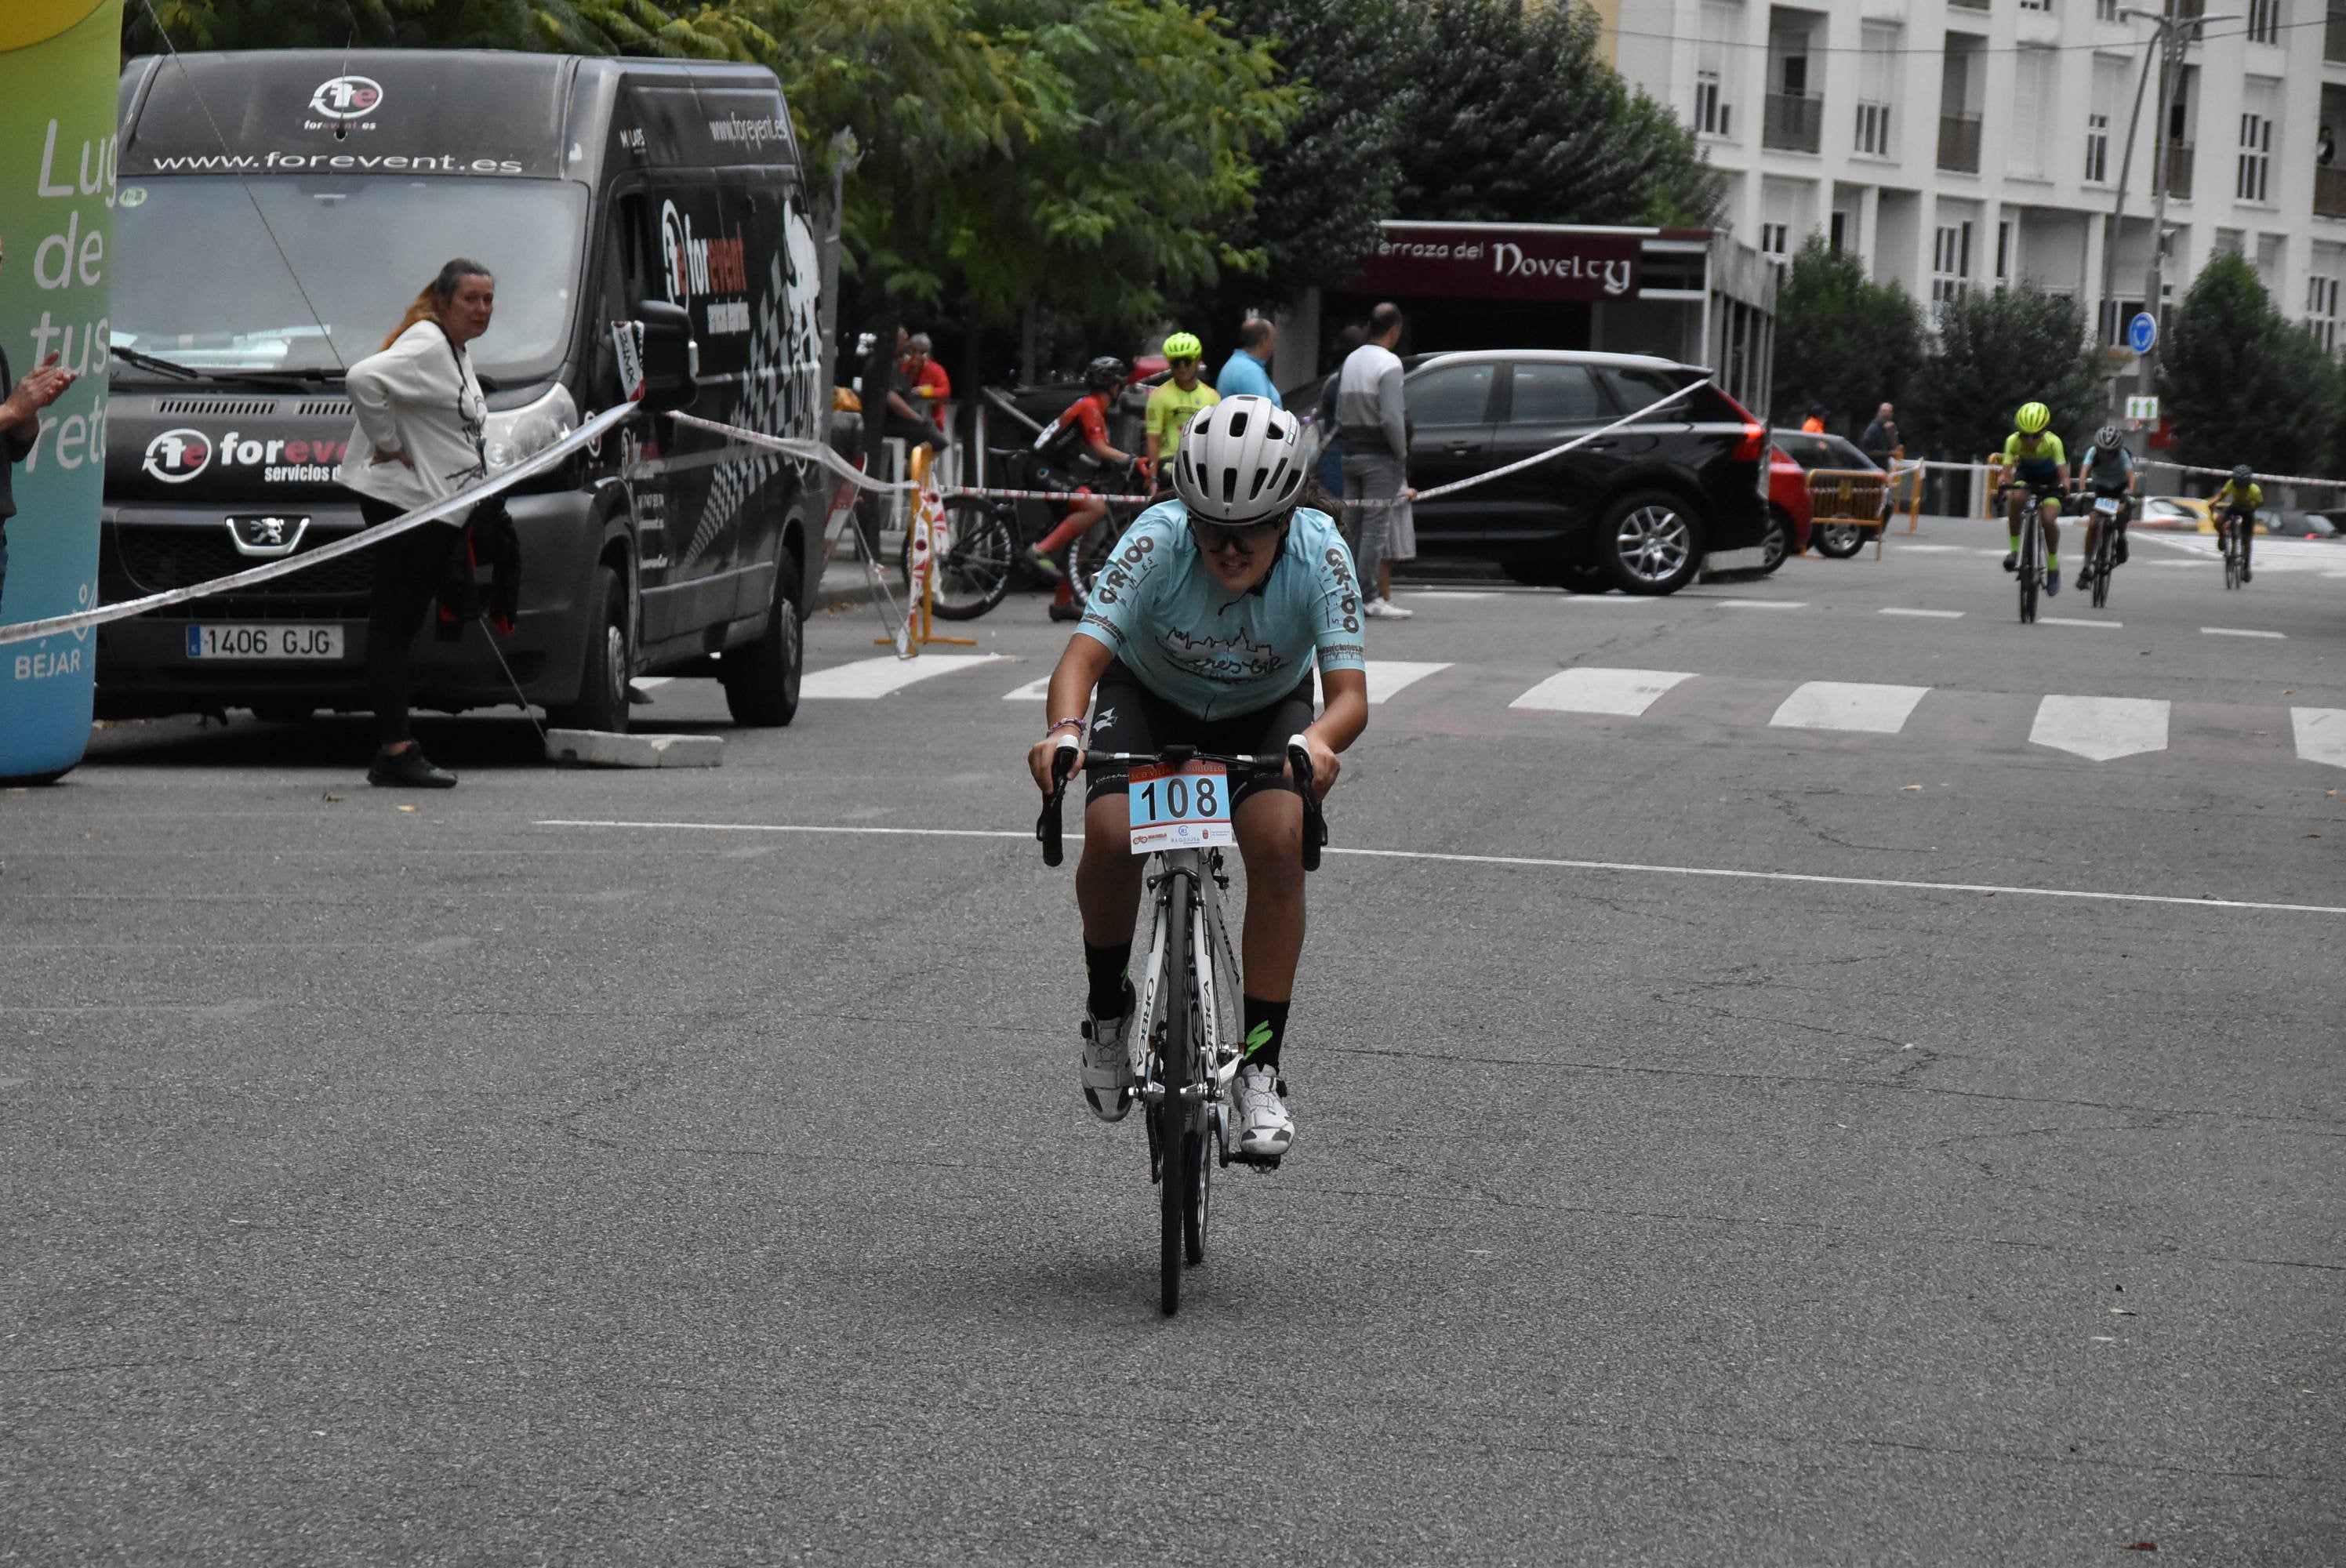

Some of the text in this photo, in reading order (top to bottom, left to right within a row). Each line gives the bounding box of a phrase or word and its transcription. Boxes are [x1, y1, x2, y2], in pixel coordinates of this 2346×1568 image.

[303, 119, 377, 131] forevnt.es
[709, 111, 788, 151] www.forevent.es
[154, 151, 523, 174] www.forevent.es
[34, 210, 103, 289] de
[685, 213, 747, 296] forevent
[1454, 241, 1484, 259] del
[1492, 242, 1632, 295] Novelty
[31, 311, 109, 377] tus
[25, 395, 108, 473] ret
[264, 464, 329, 482] servicios
[15, 639, 81, 681] BÉJAR
[208, 629, 331, 655] 1406 GJG
[1141, 778, 1218, 821] 108
[1137, 978, 1154, 1067] ORBEA
[1204, 980, 1215, 1071] ORBEA
